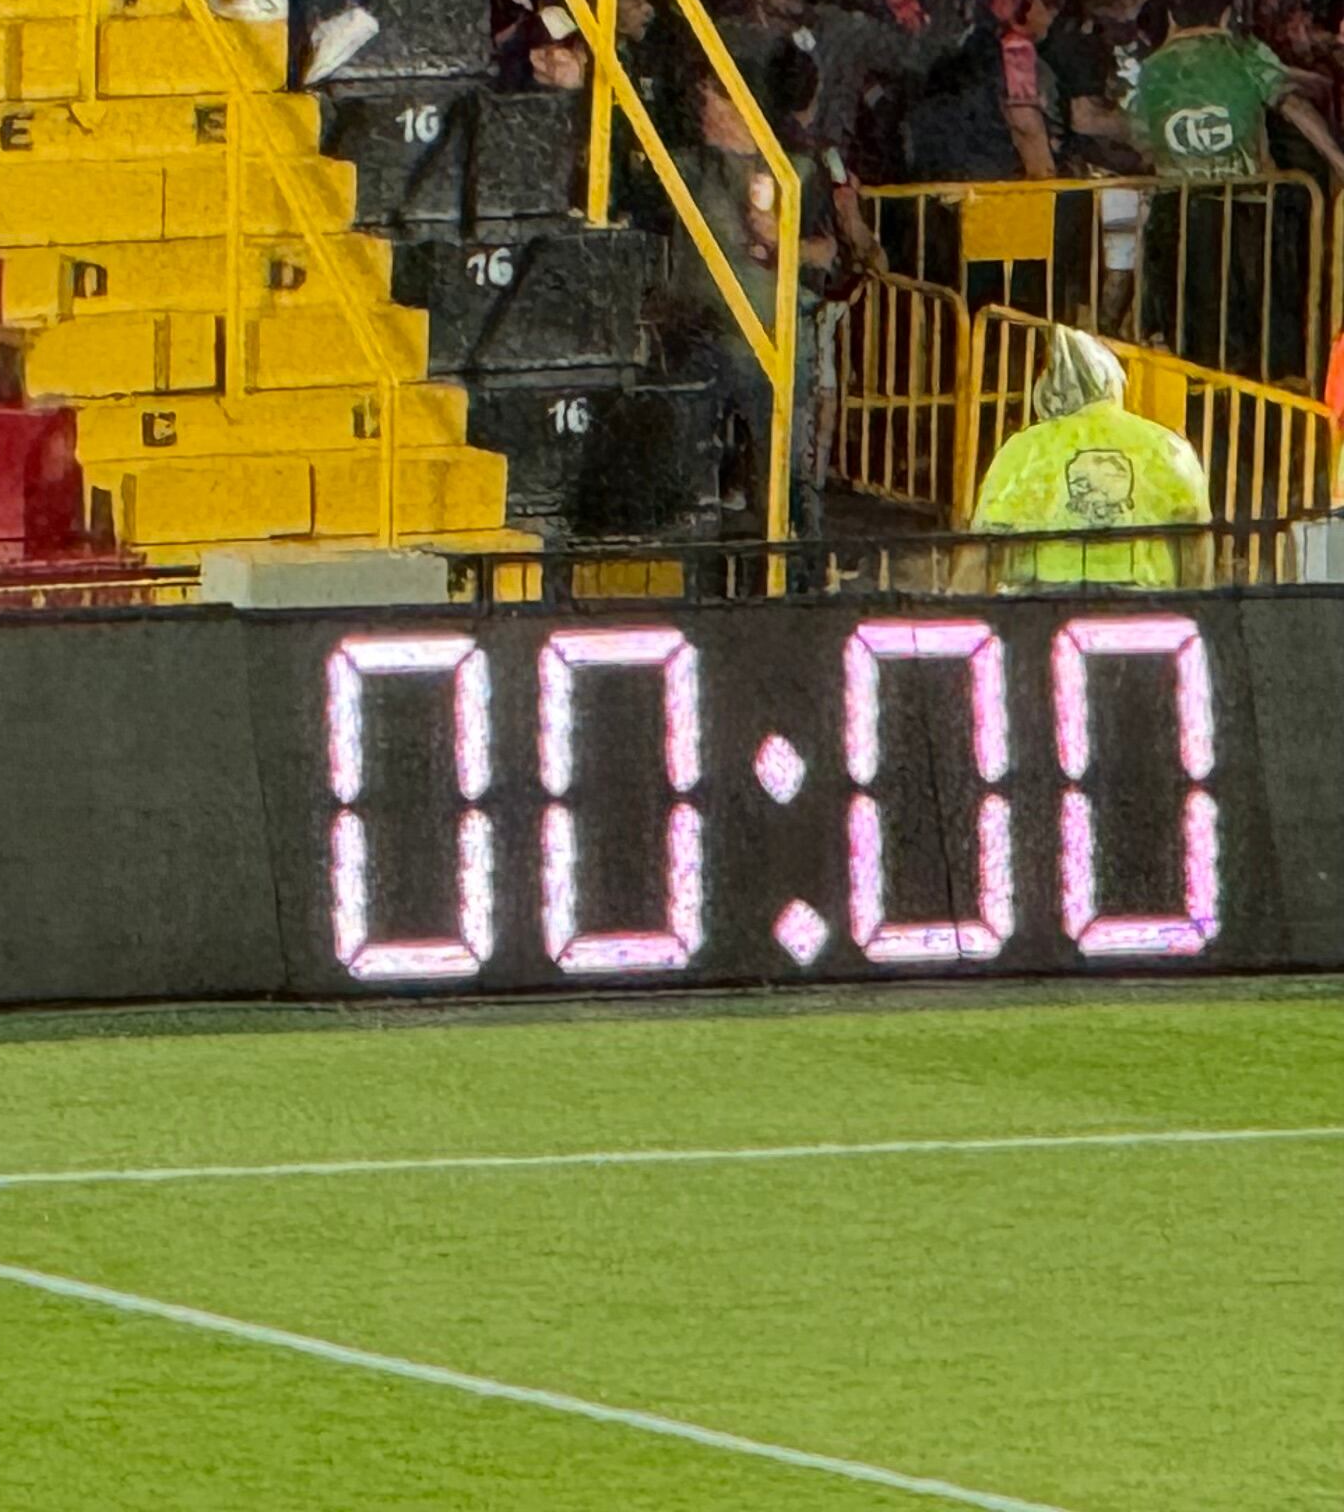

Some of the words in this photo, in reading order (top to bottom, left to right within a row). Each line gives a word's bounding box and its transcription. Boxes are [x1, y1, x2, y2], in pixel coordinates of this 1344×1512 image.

[0, 113, 34, 152] E
[395, 104, 441, 143] 16
[465, 247, 514, 287] 16
[547, 397, 591, 434] 16
[325, 613, 1222, 980] 00:00
